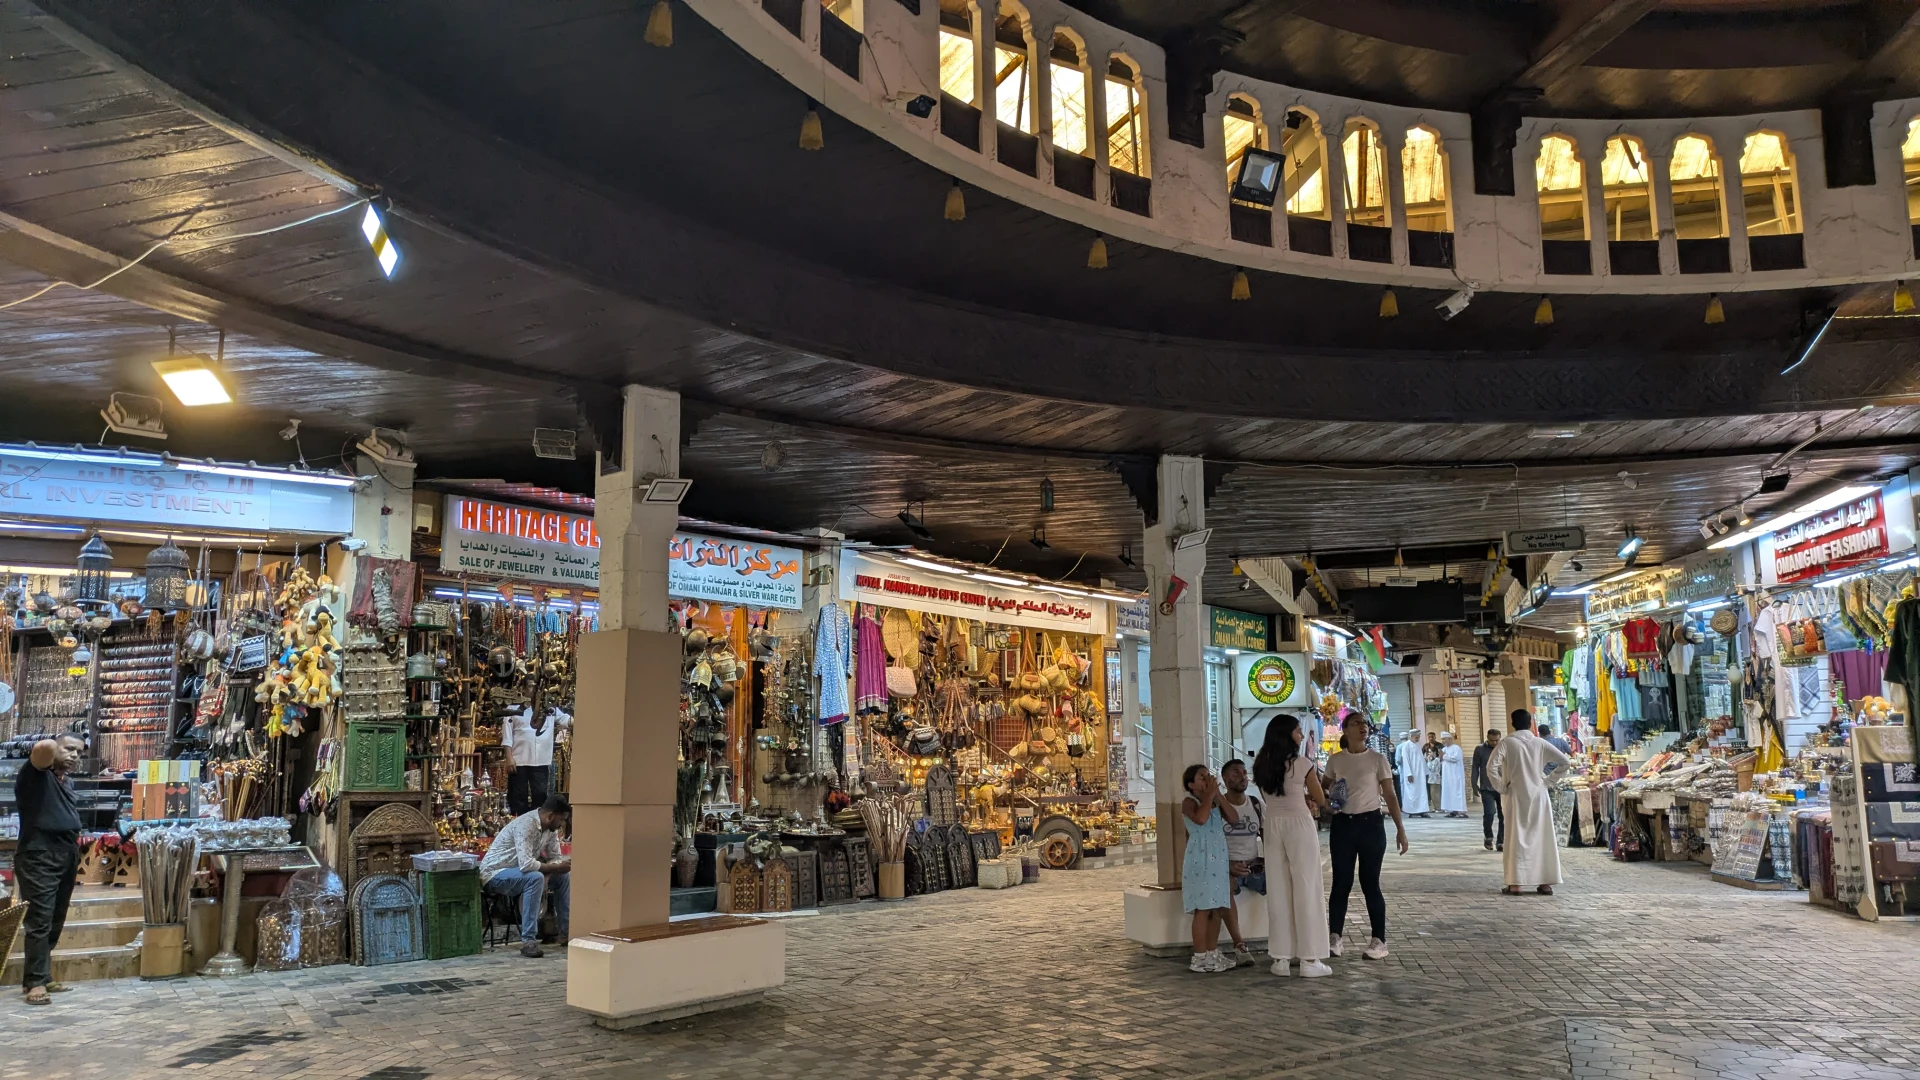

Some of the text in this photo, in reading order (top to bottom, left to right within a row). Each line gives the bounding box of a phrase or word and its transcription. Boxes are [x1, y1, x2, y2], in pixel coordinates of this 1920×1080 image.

[0, 459, 124, 484] السودا
[46, 485, 253, 516] INVESTMENT
[459, 500, 600, 549] HERITAGE CE
[1521, 532, 1570, 543] ممنوع التدخين
[1539, 541, 1565, 549] Smoking
[554, 551, 589, 566] العمانية
[735, 545, 799, 580] مركز
[1776, 550, 1804, 576] OMAN
[1803, 543, 1830, 567] GULF
[1829, 527, 1882, 560] FASHION
[459, 556, 481, 569] SALE
[483, 558, 495, 569] OF
[497, 560, 546, 576] JEWELLERY
[552, 567, 559, 577] &
[559, 567, 599, 581] VALUABLE
[678, 582, 701, 593] OMANI
[702, 586, 732, 598] KHANJAR
[733, 589, 738, 598] &
[739, 590, 760, 600] SILVER
[761, 592, 778, 602] WARE
[780, 595, 797, 605] GIFTS
[856, 574, 987, 607] ROYAL HANDICRAFTS GIFTS CENTER
[1214, 630, 1231, 646] OMANI
[1247, 635, 1266, 651] CORNER
[1277, 679, 1295, 702] CORNER
